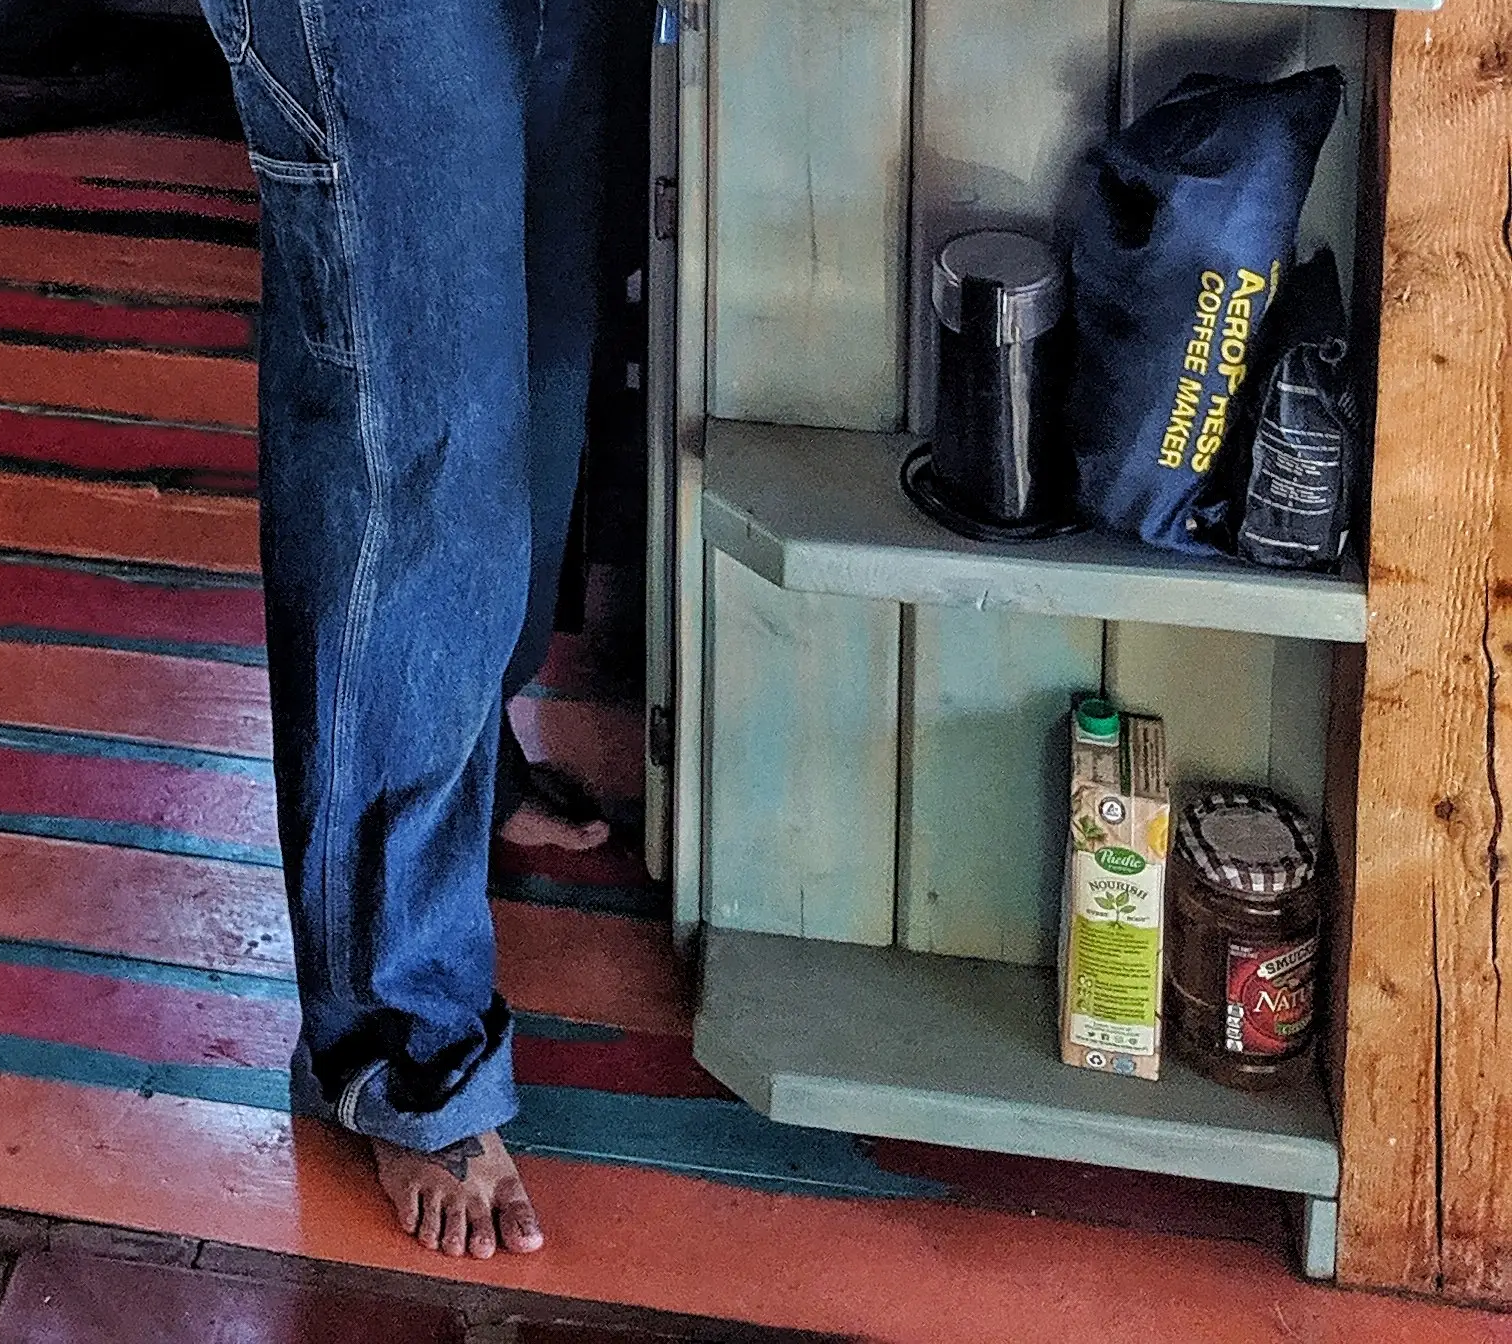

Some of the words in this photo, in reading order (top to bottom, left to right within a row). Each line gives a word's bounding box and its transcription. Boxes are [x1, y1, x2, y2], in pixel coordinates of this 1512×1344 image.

[1183, 270, 1226, 376] COFFEE
[1157, 376, 1203, 470] MAKER
[1088, 879, 1148, 900] NOURISH
